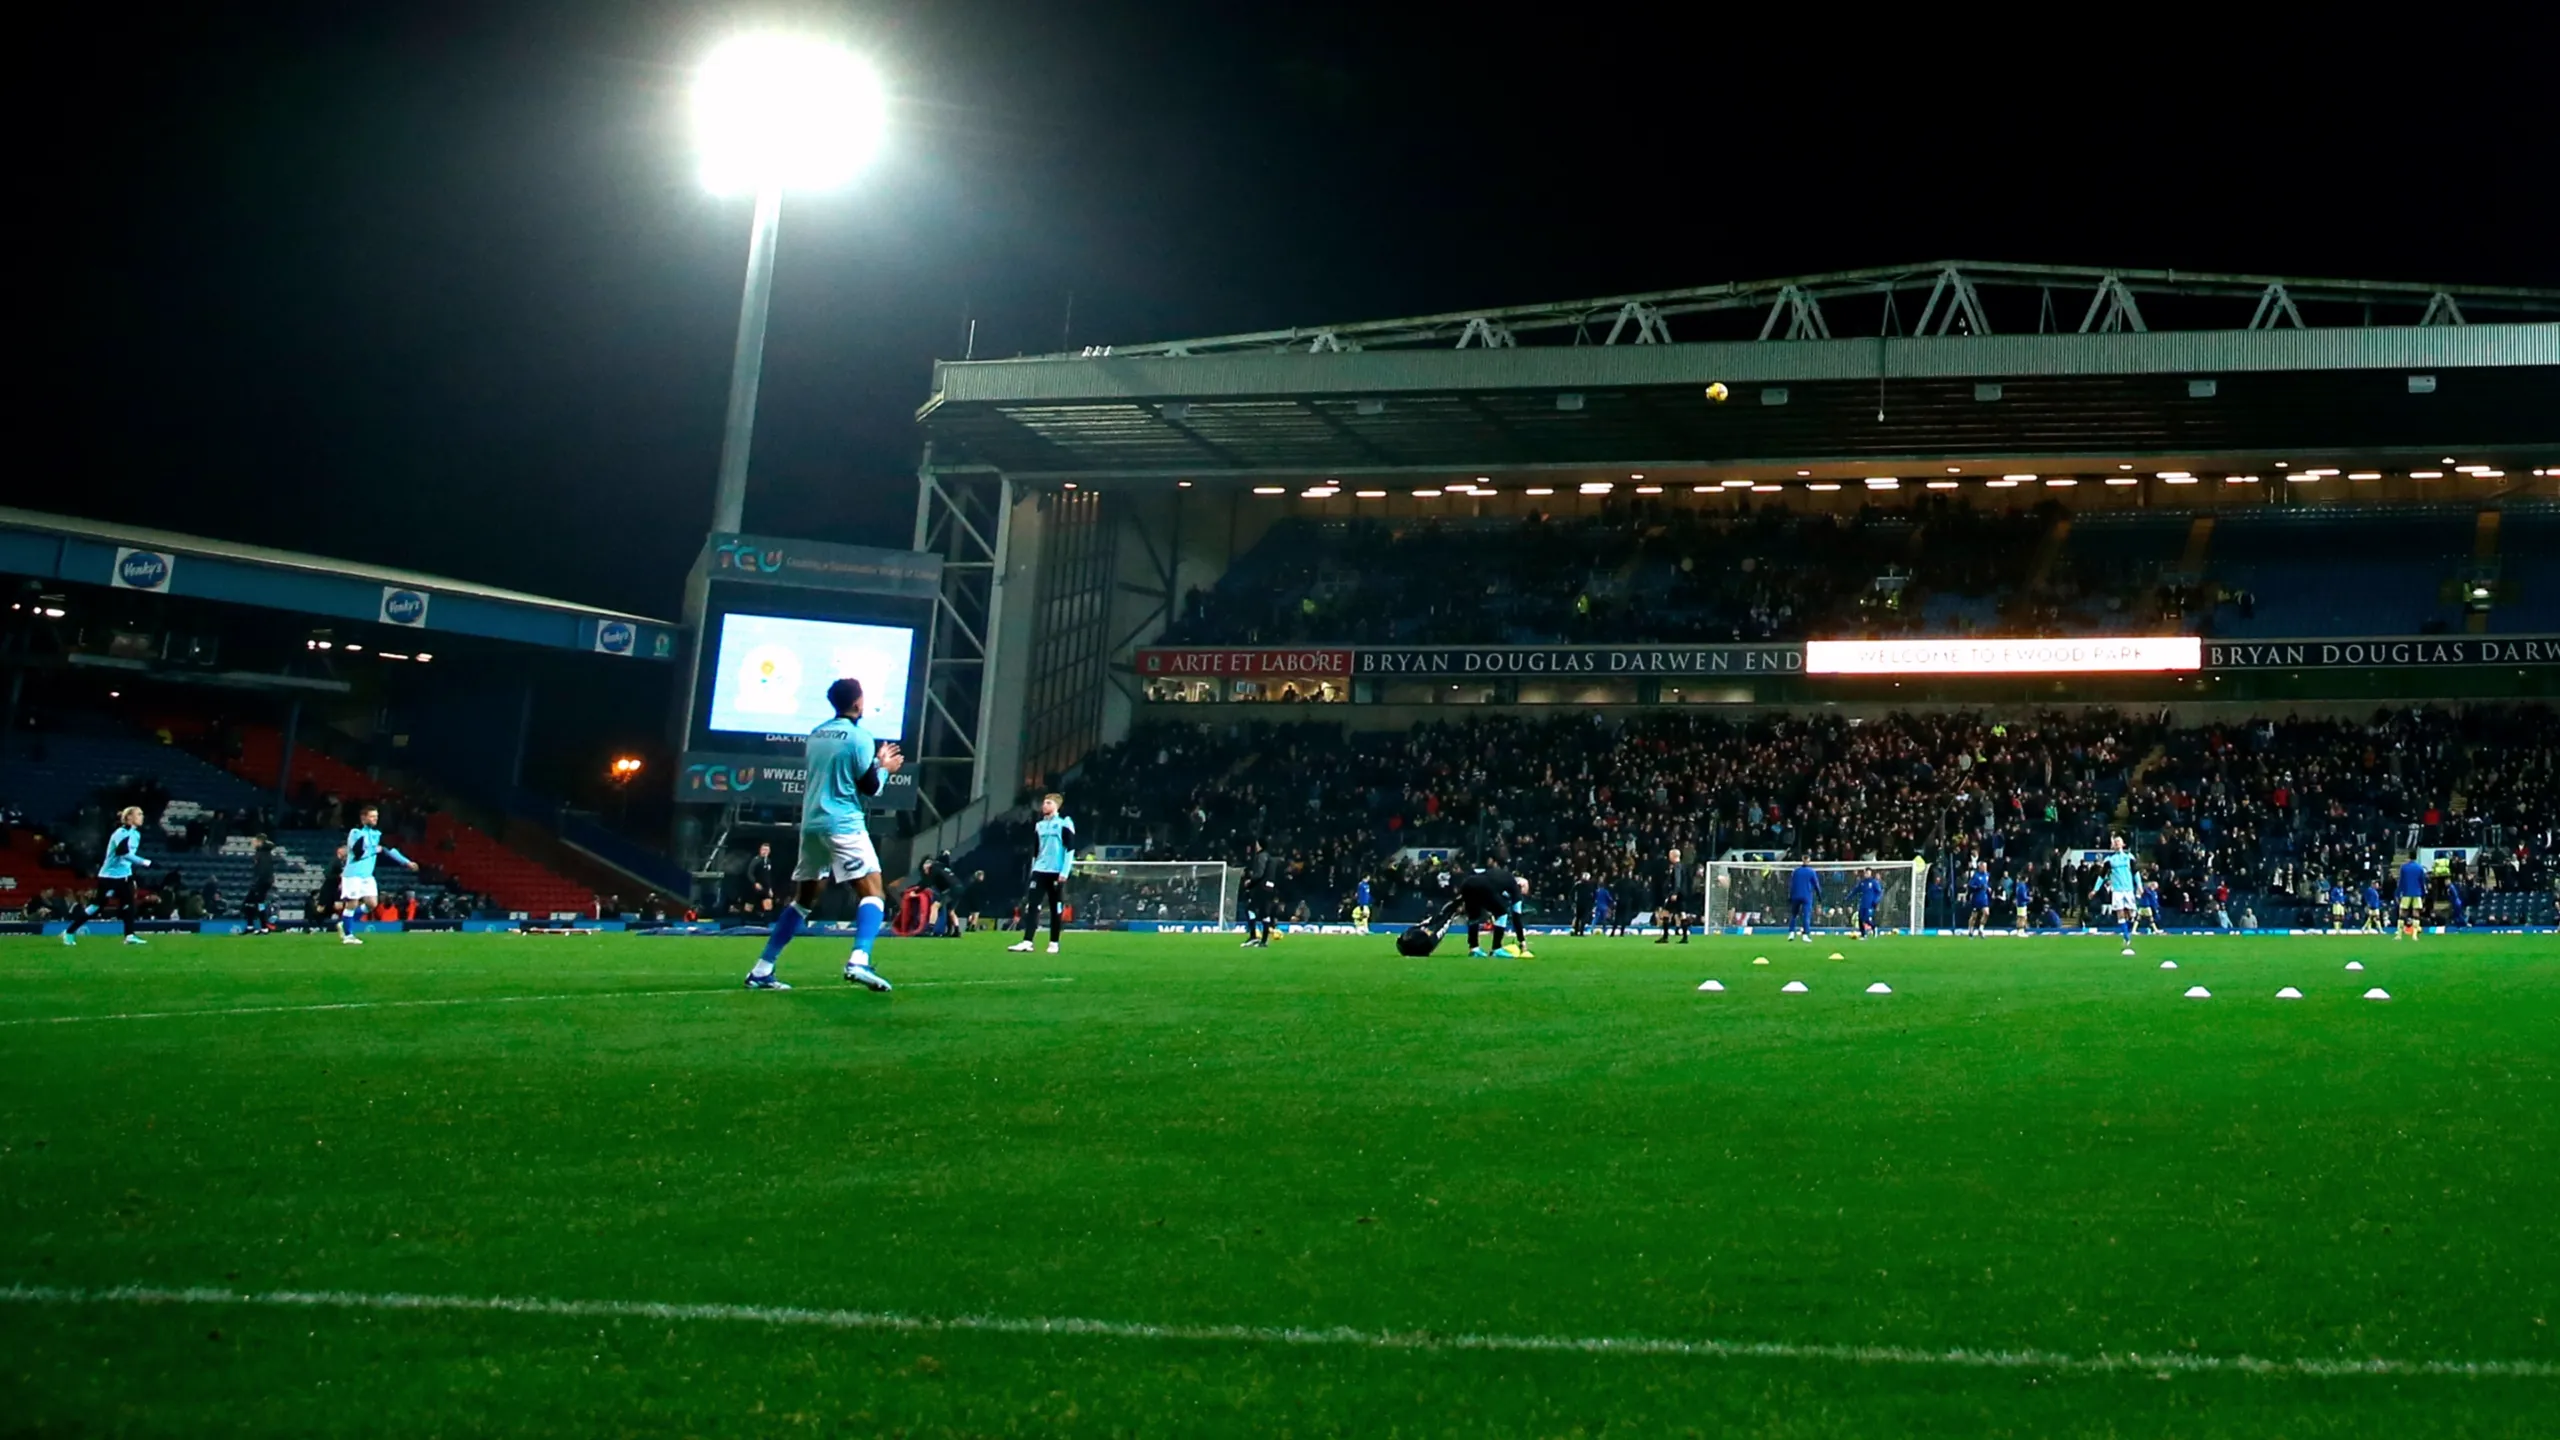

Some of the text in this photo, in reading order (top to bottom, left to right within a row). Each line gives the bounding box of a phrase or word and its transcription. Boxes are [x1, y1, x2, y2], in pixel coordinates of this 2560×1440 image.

[123, 561, 162, 580] Venky's
[1171, 653, 1343, 672] ARTE ET LABORE
[1363, 651, 1802, 672] BRYAN DOUGLAS DARWEN END
[1971, 648, 1991, 664] TO
[2211, 646, 2304, 665] BRYAN
[2322, 643, 2464, 664] DOUGLAS
[781, 781, 804, 794] TEL:
